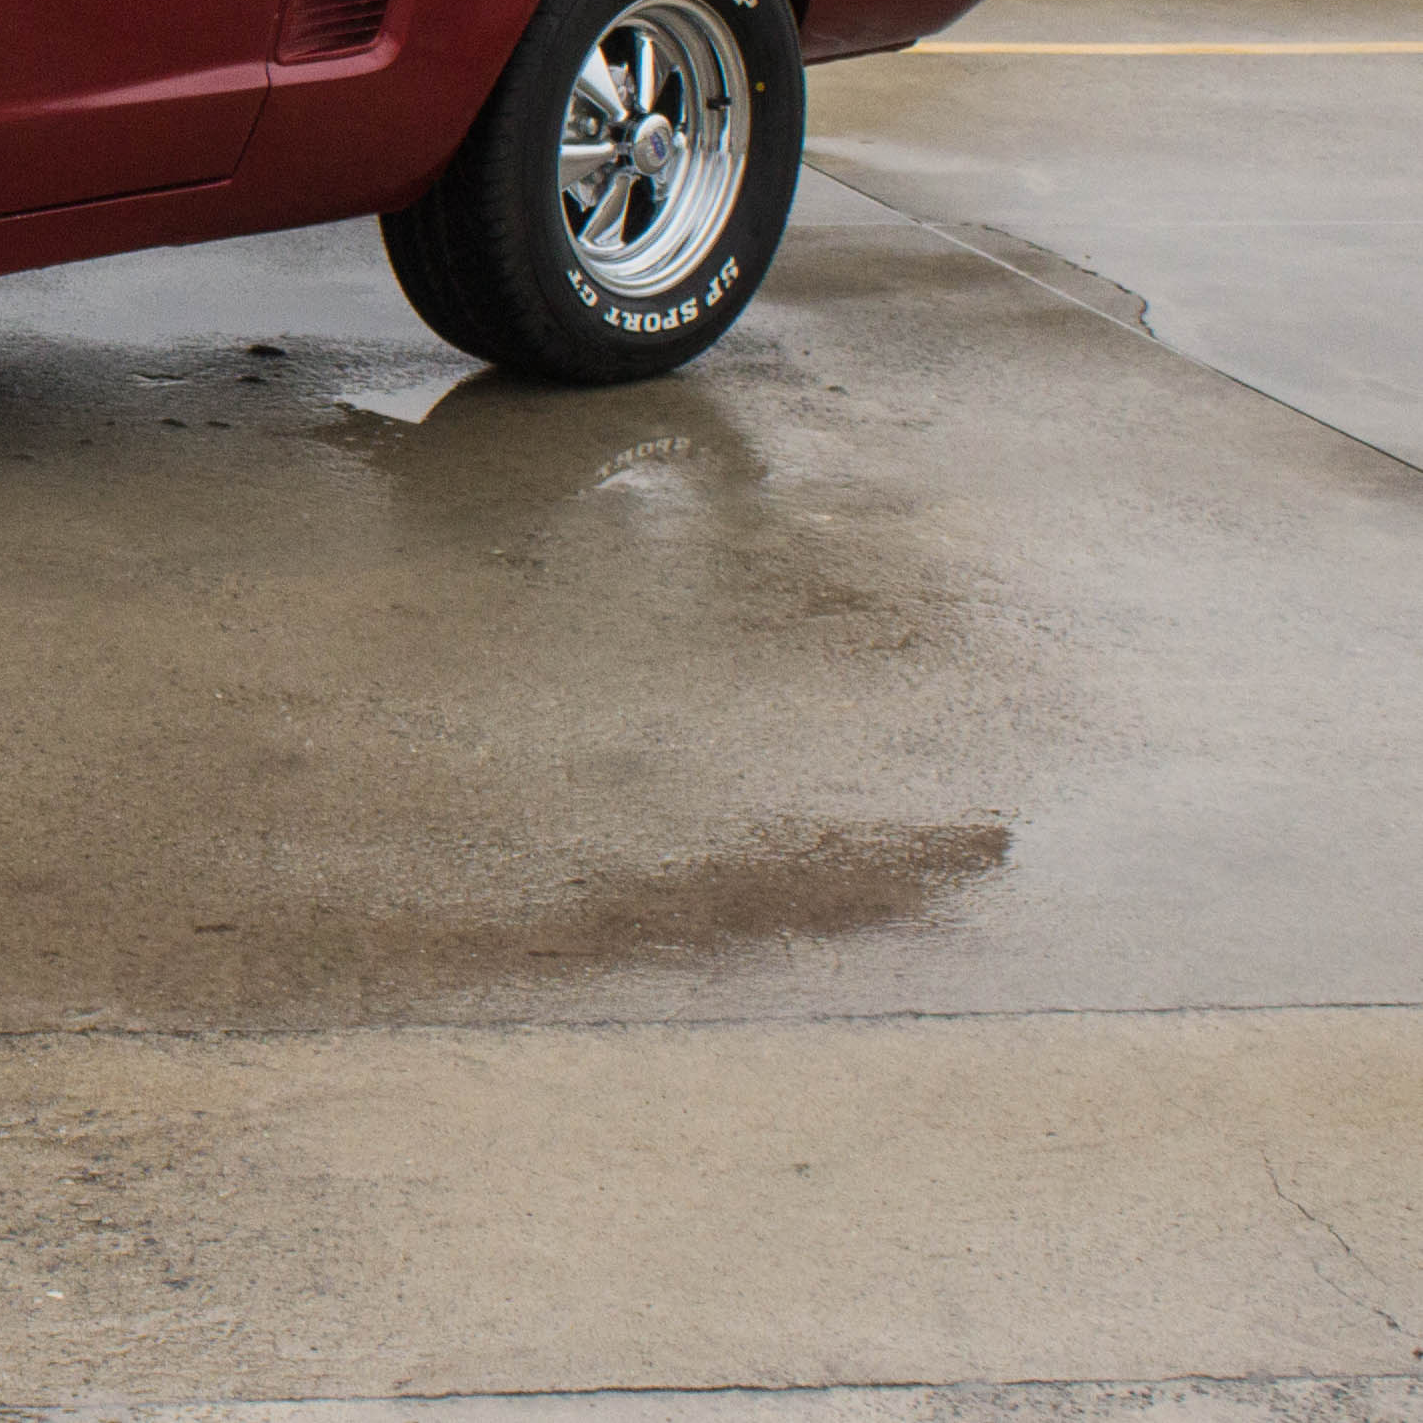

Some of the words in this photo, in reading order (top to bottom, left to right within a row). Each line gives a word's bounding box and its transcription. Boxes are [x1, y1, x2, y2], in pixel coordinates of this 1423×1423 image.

[565, 267, 599, 308] GT
[706, 255, 740, 308] SP
[604, 298, 699, 334] SPORT
